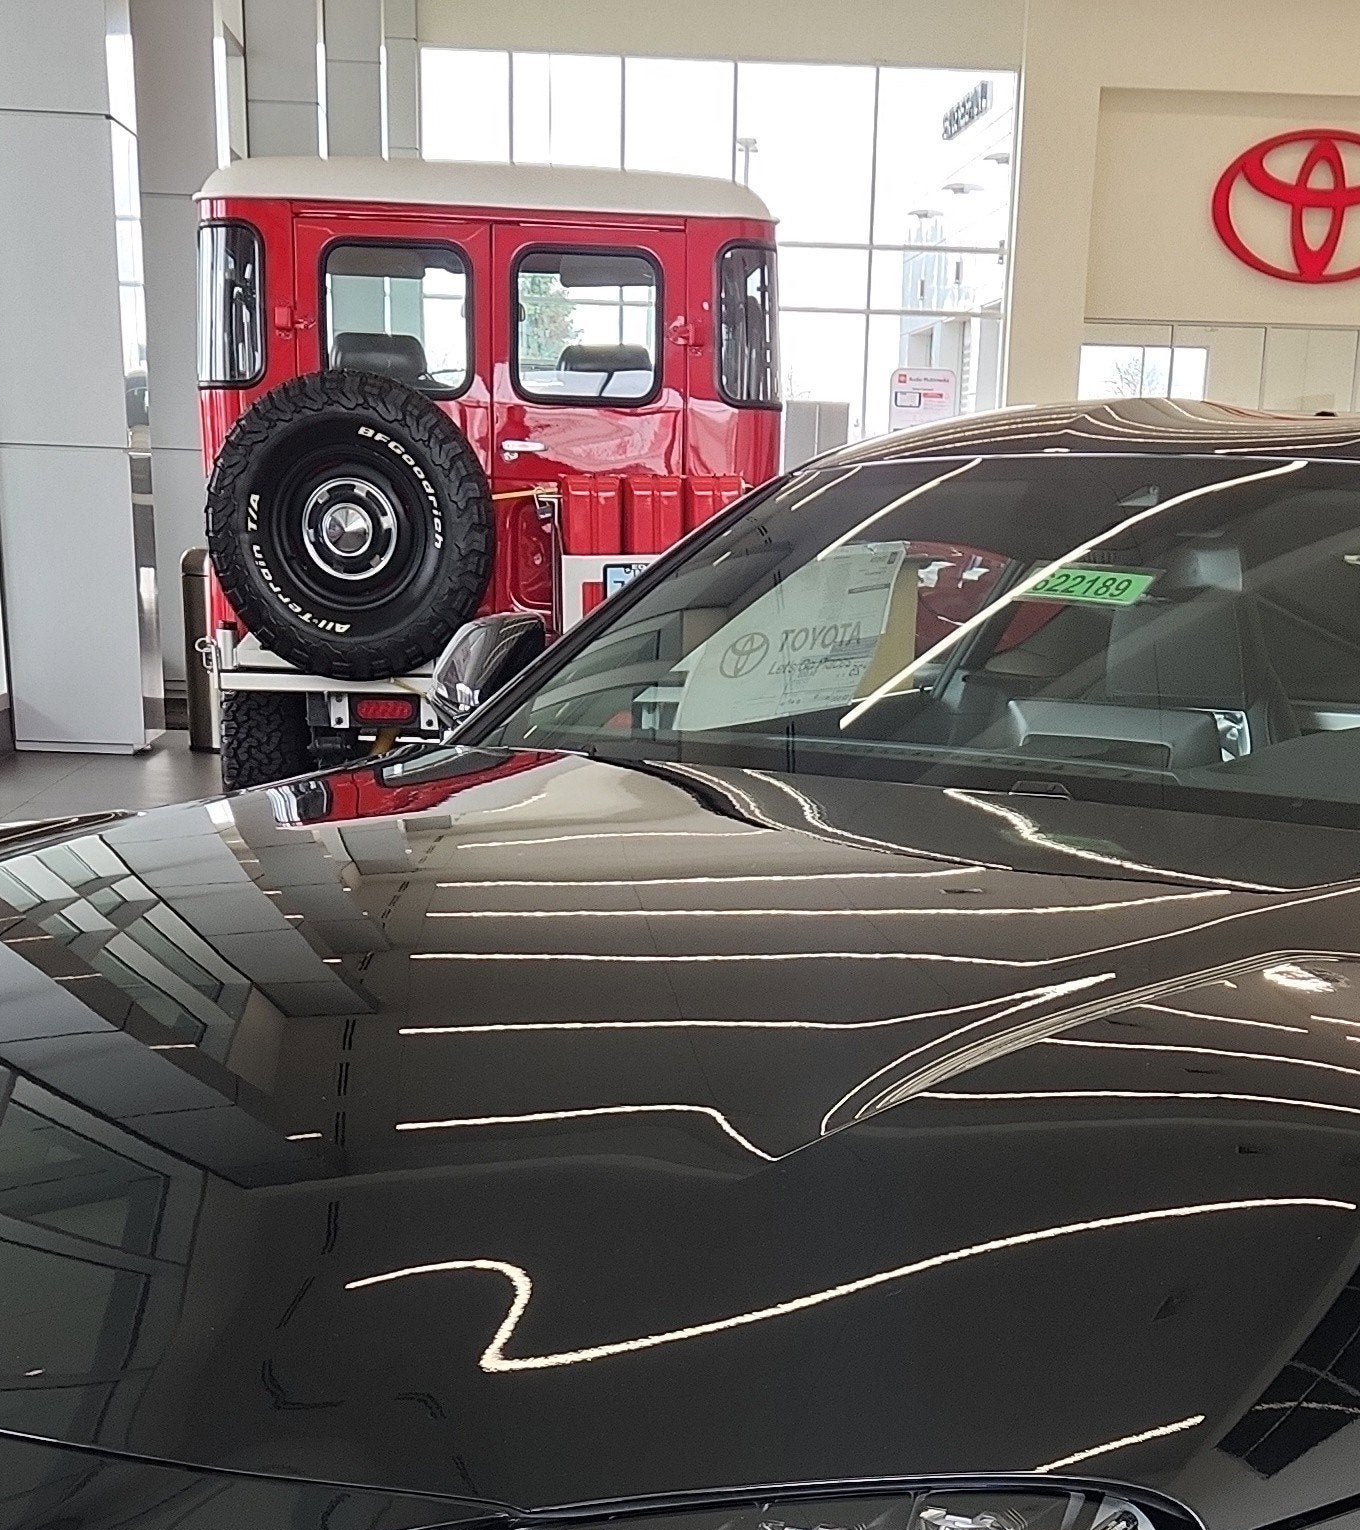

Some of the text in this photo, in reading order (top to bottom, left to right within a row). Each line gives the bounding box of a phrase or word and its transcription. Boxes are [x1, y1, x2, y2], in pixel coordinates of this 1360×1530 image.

[357, 425, 445, 549] BFGoodrich
[247, 494, 351, 633] All-Terrain T/A
[778, 621, 863, 652] TOYOTA
